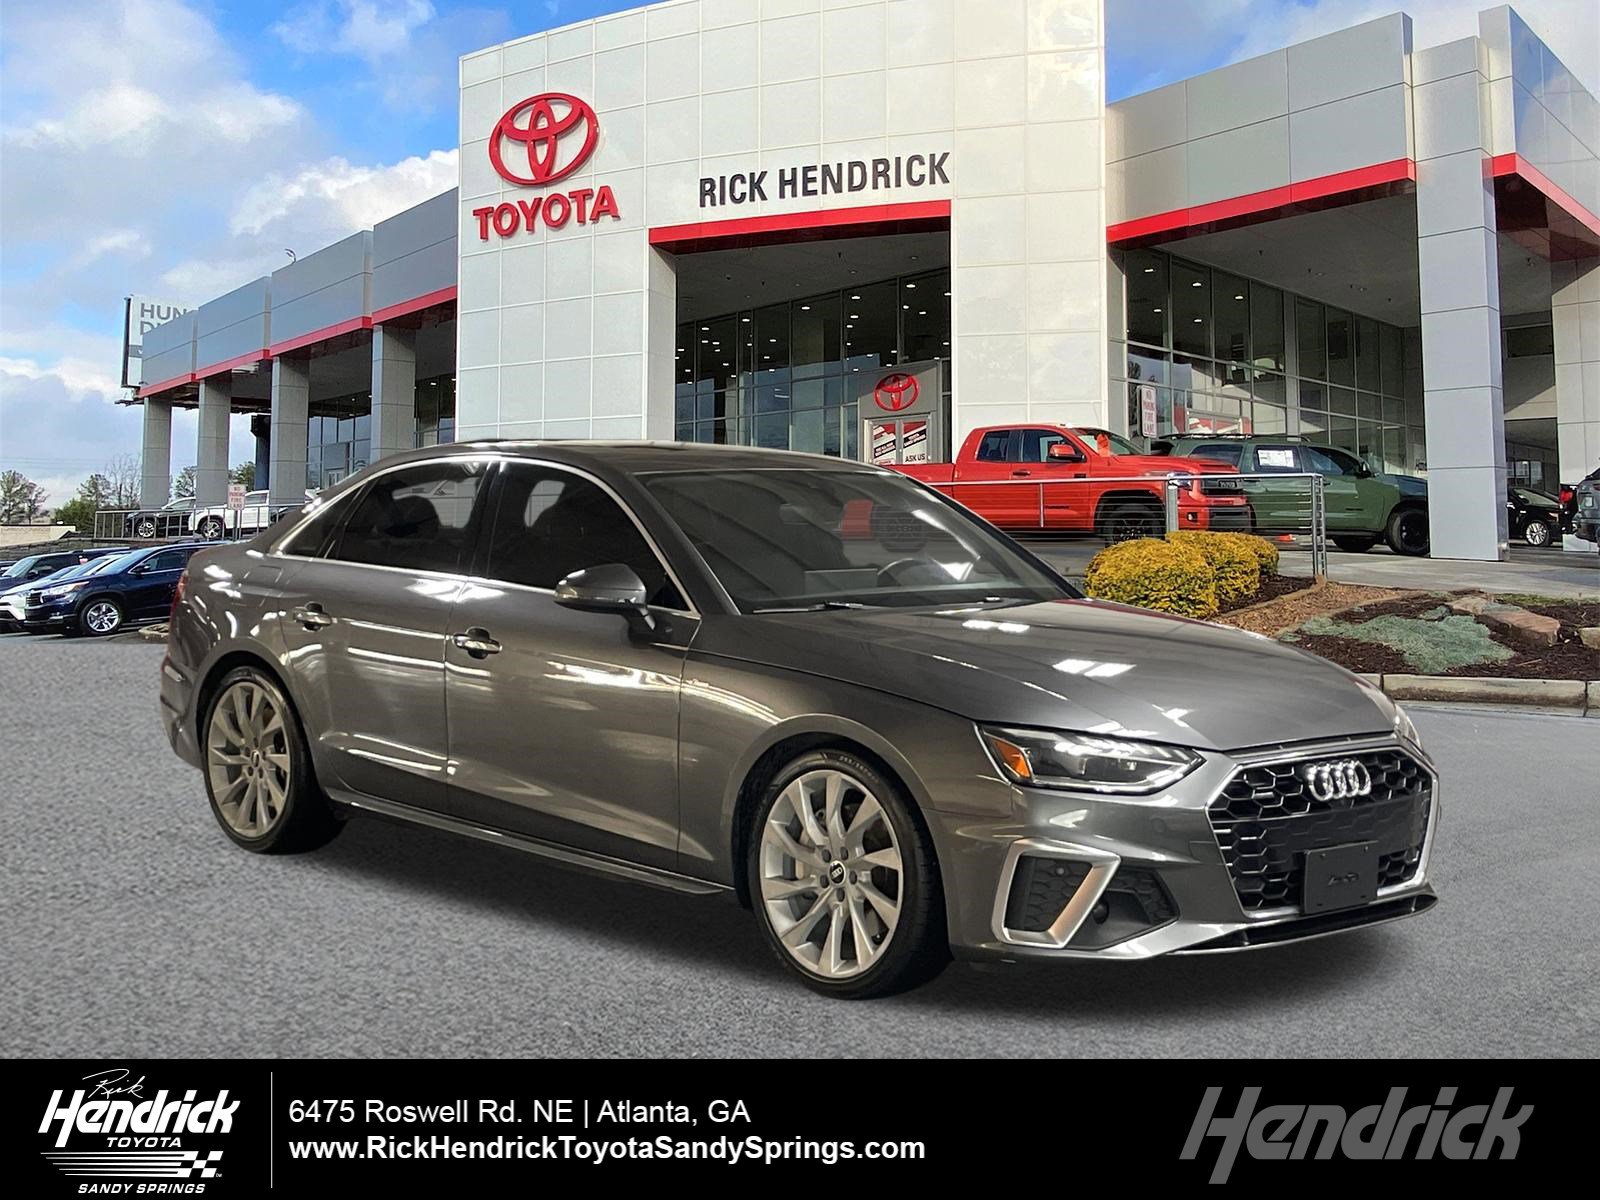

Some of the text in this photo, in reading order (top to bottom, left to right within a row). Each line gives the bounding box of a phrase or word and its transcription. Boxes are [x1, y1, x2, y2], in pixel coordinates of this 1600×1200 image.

[700, 152, 950, 208] RICK HENDRICK
[472, 185, 621, 241] TOYOTA
[917, 453, 926, 461] US
